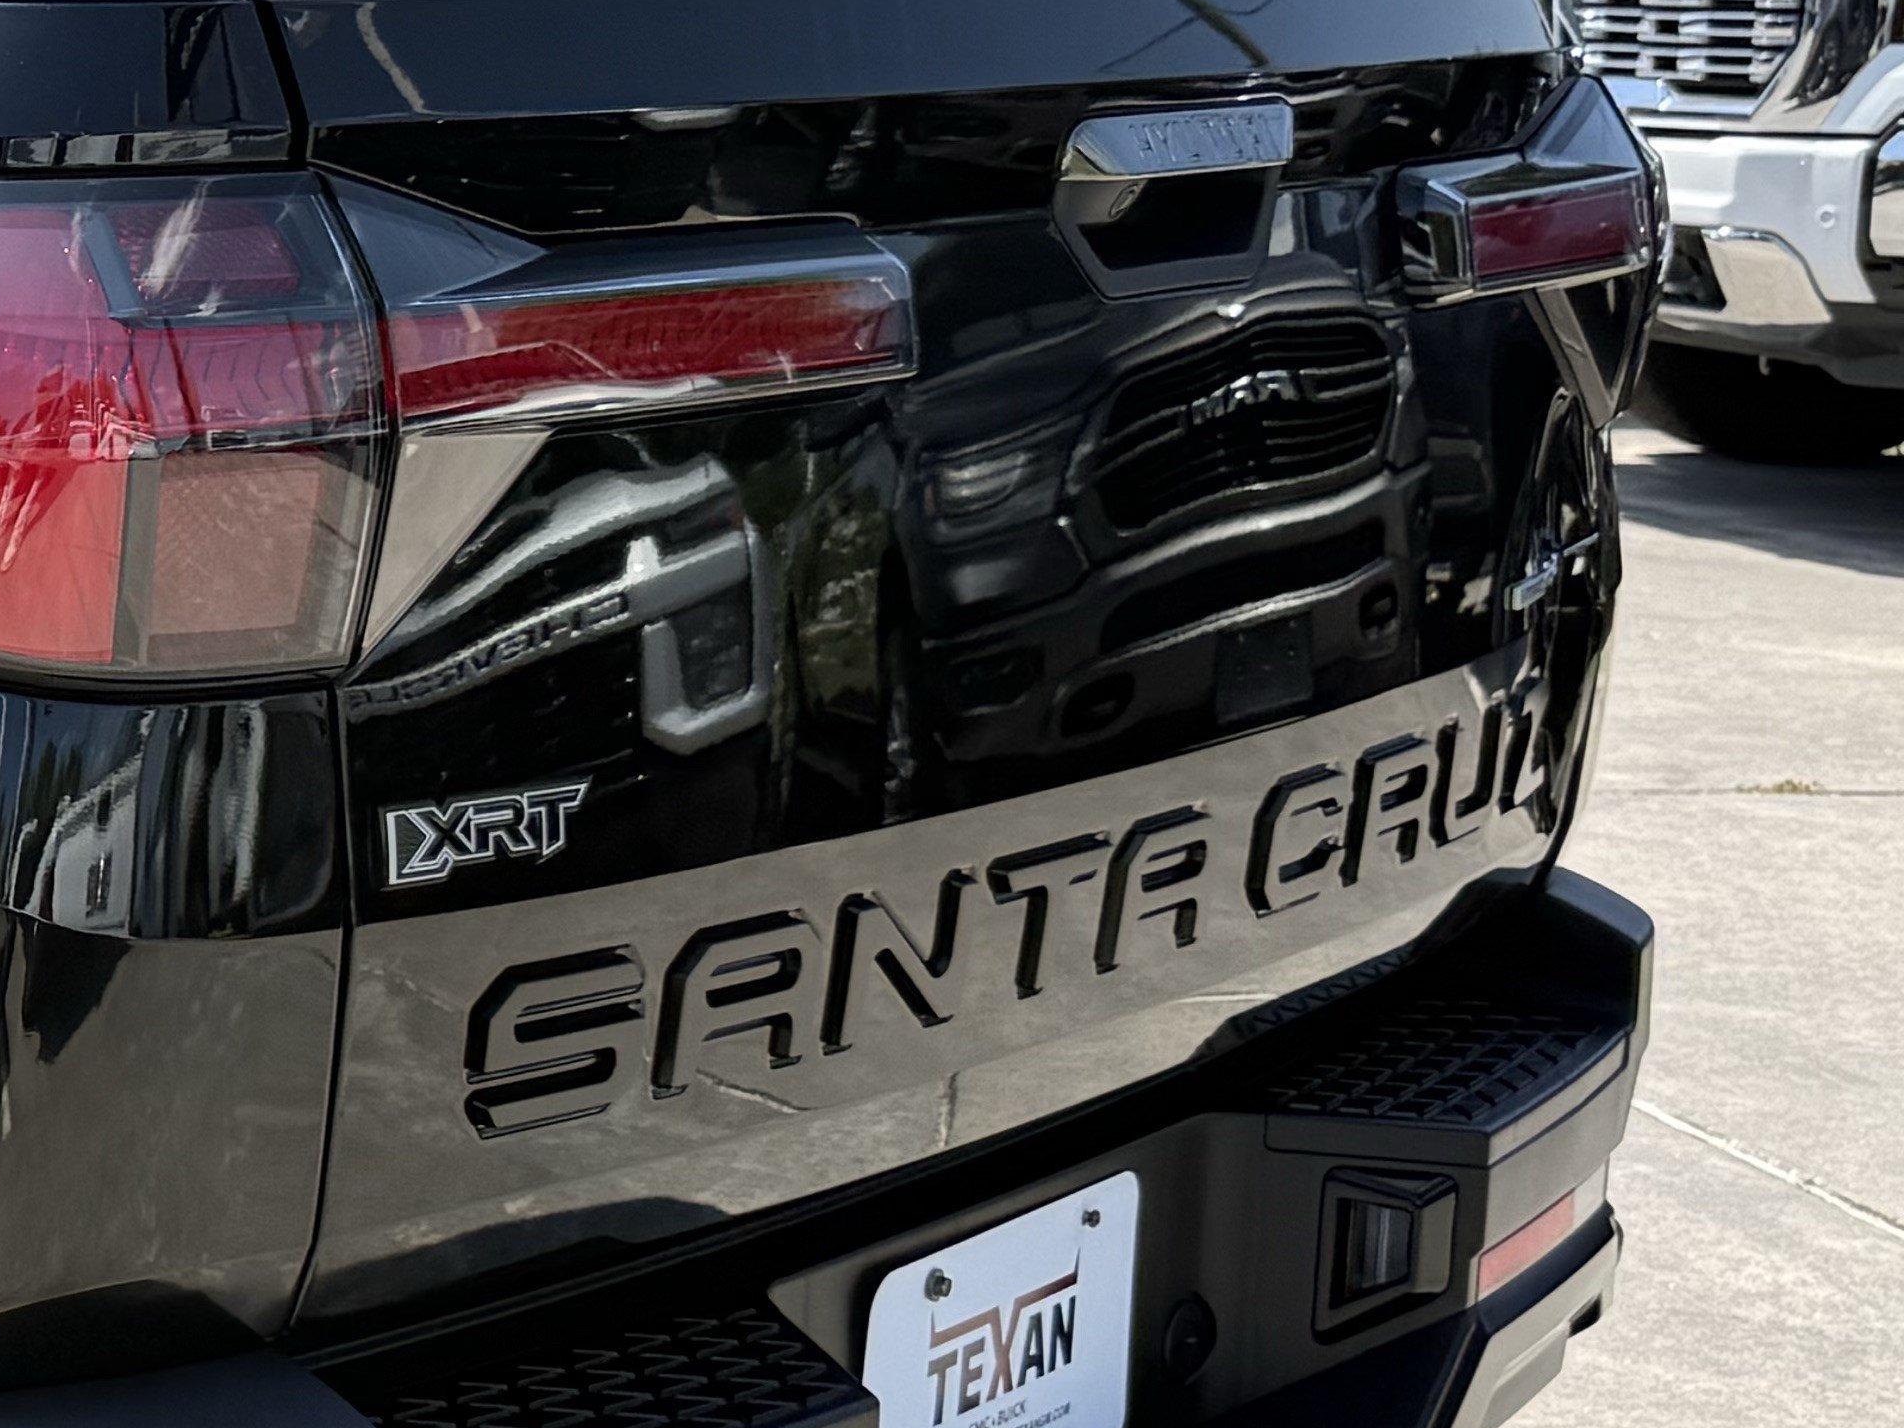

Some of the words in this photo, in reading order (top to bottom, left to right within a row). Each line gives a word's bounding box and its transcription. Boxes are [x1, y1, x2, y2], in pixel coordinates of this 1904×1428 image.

[384, 779, 593, 888] XRT
[464, 803, 1210, 1140] SANTA
[925, 1294, 1078, 1428] TEXAN
